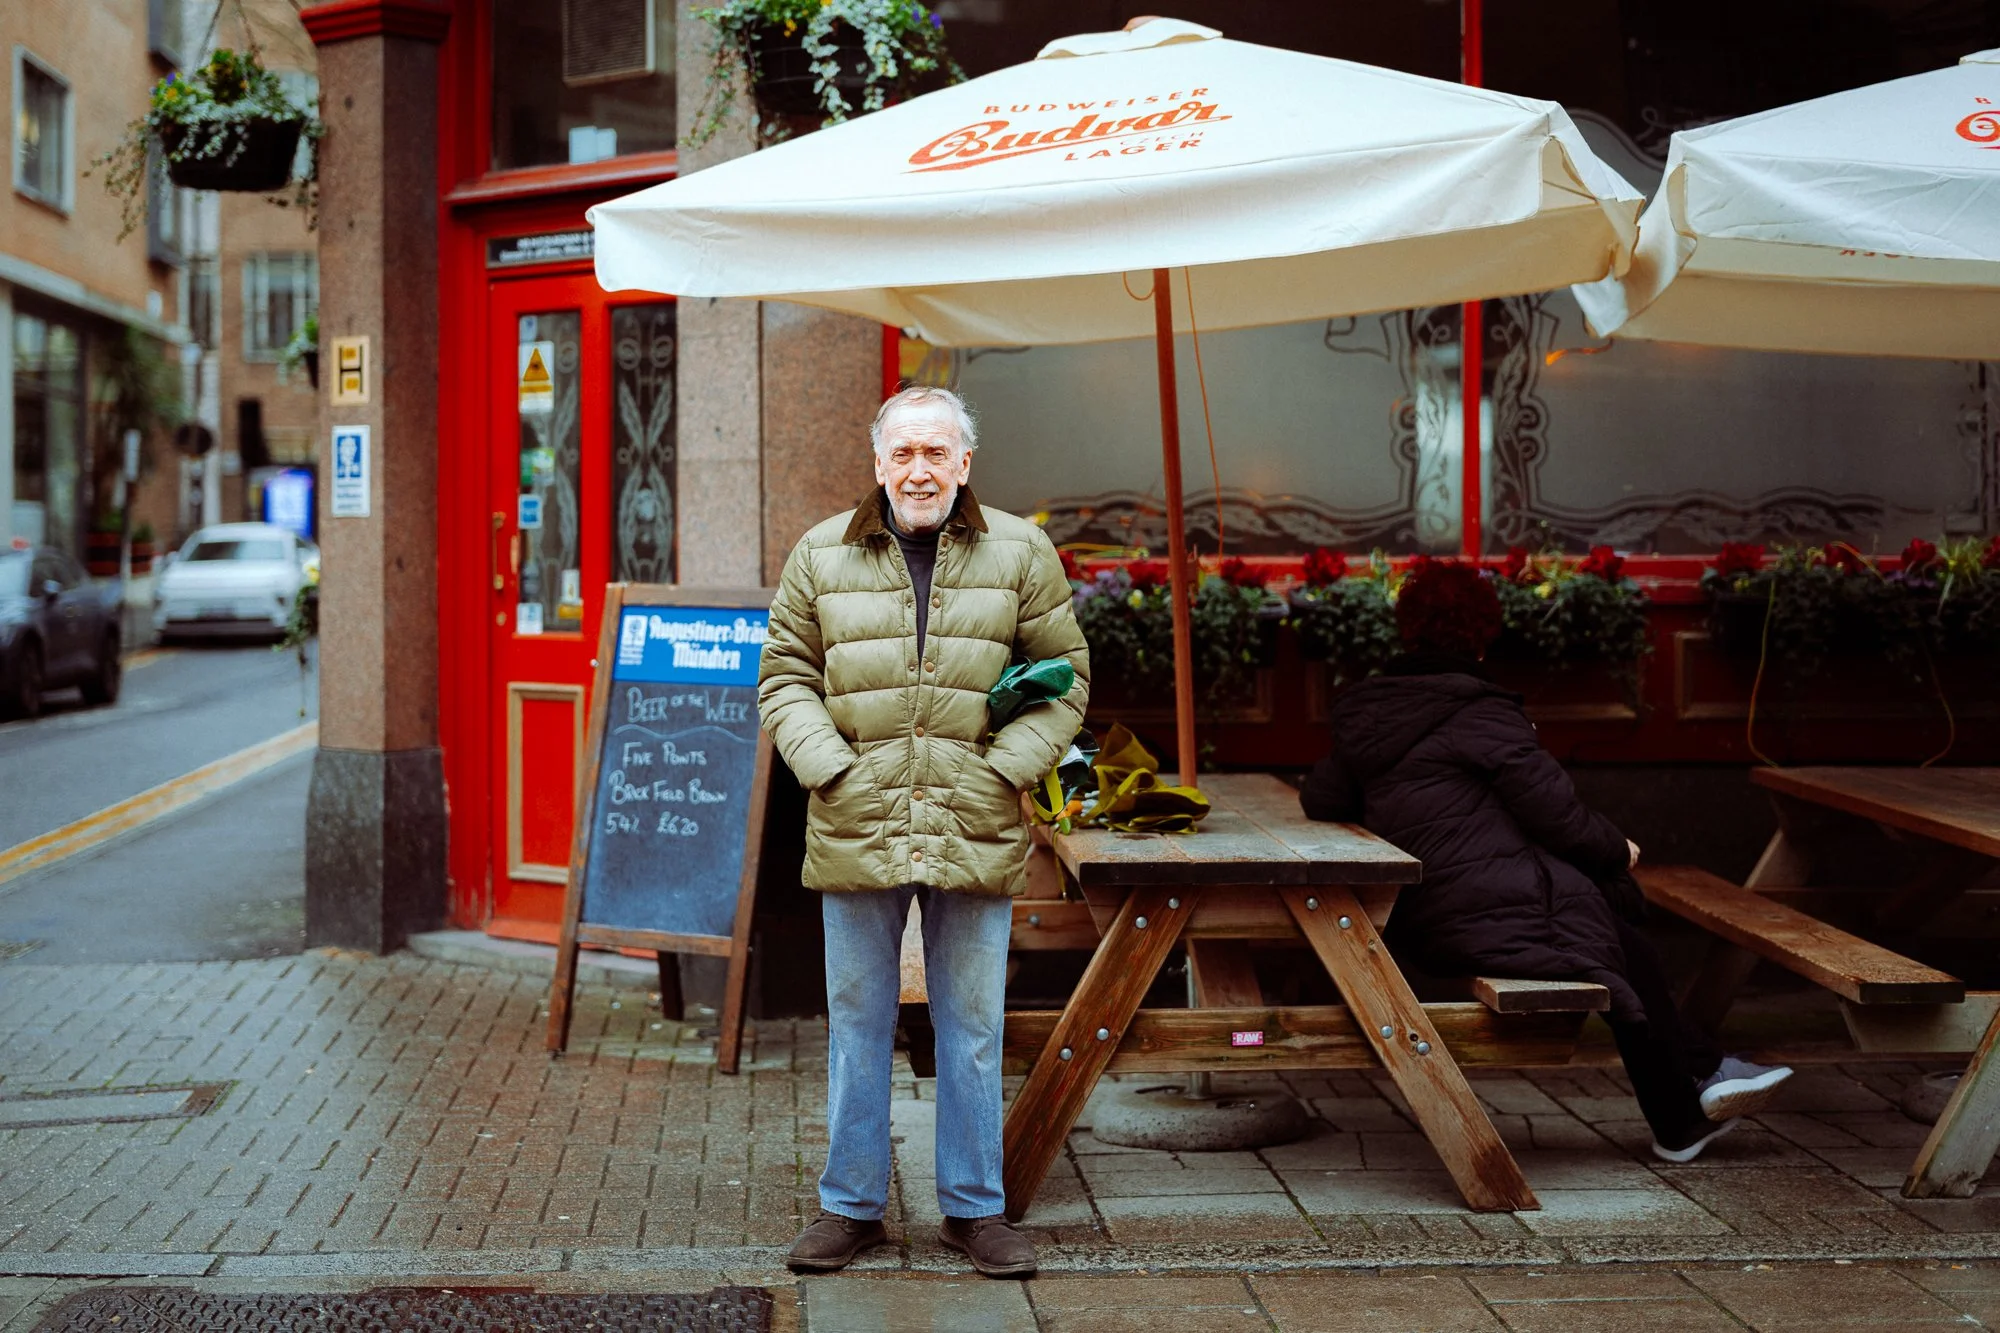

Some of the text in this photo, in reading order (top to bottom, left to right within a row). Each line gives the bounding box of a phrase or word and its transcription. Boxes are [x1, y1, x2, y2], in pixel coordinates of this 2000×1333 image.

[983, 87, 1209, 114] BUDWEISER
[908, 101, 1232, 166] Budvar
[1064, 139, 1201, 161] LAGER
[672, 642, 741, 670] München
[627, 686, 668, 723] BEER
[704, 687, 750, 722] WEEK
[622, 741, 653, 769] FIVE
[1236, 1032, 1259, 1044] RAW
